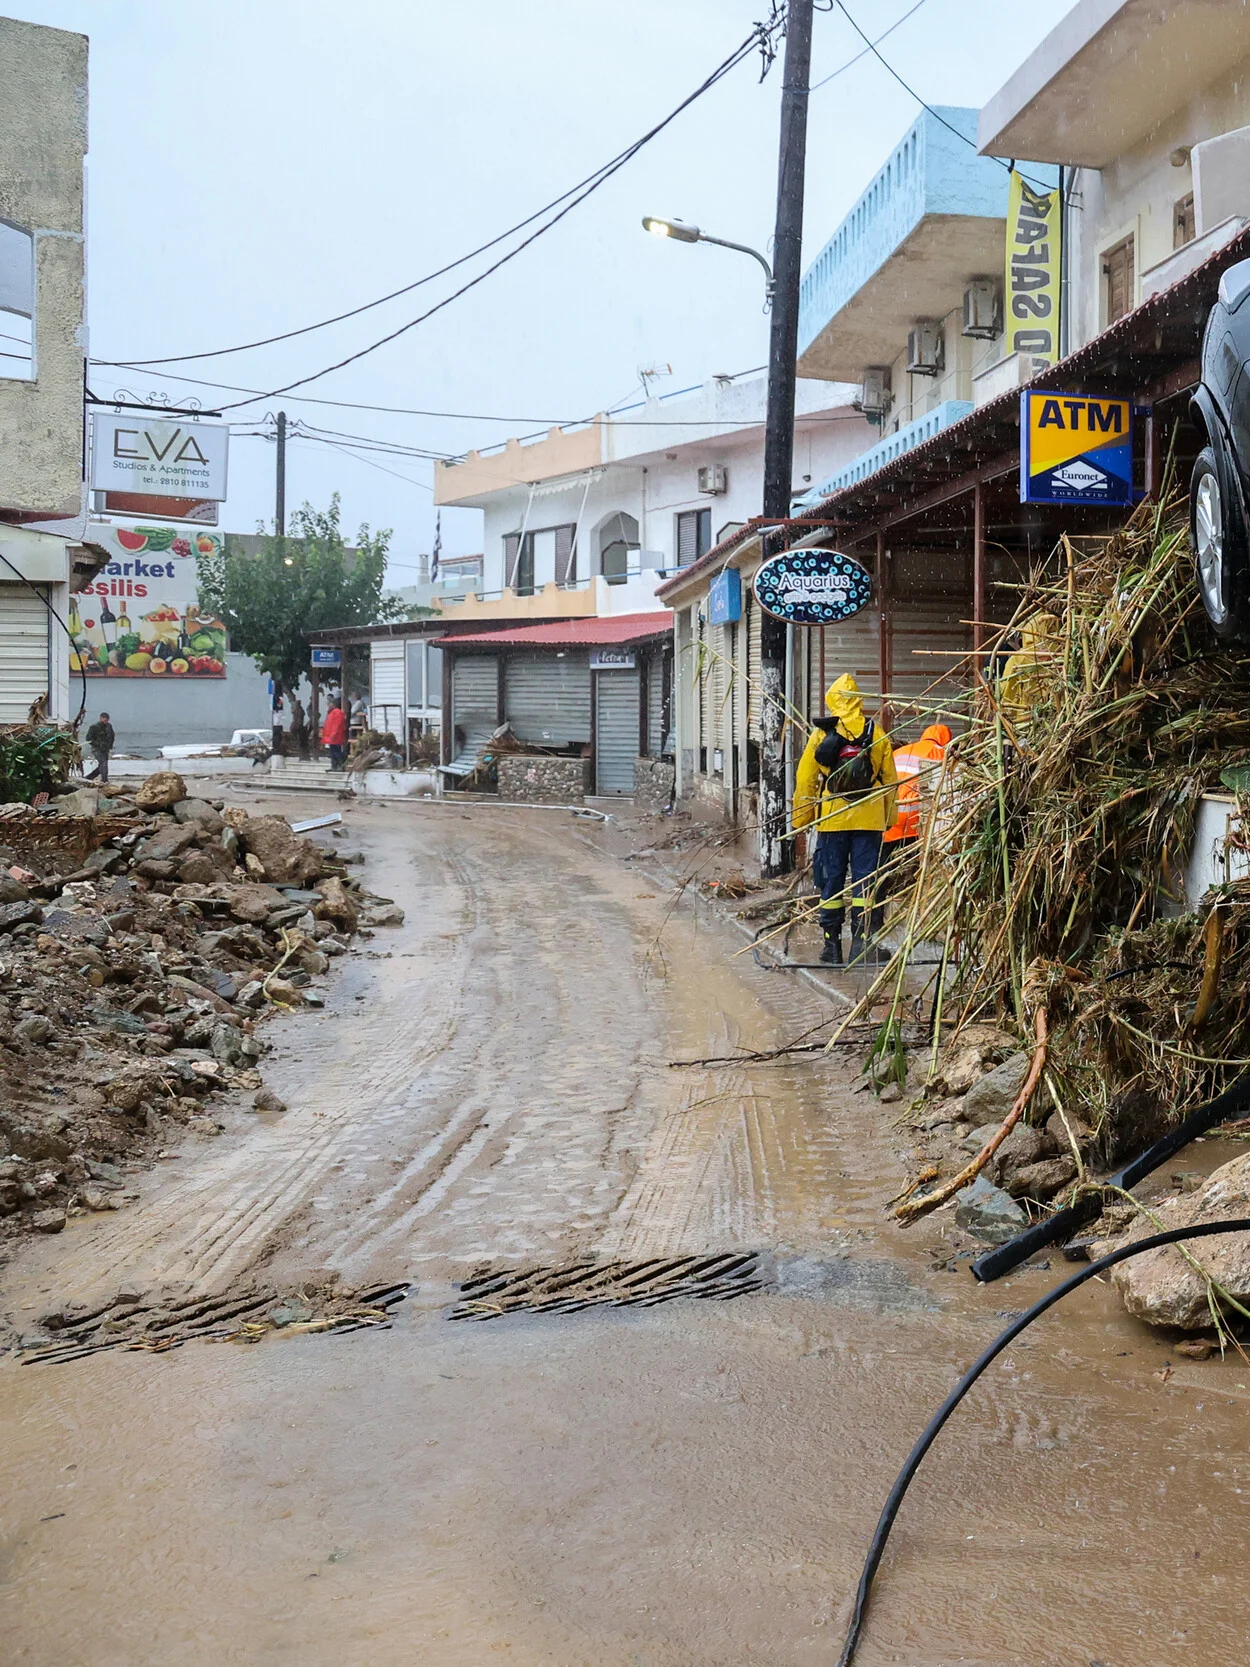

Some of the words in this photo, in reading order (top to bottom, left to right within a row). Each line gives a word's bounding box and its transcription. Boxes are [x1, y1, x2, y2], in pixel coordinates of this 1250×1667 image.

[1037, 399, 1123, 434] ATM
[113, 428, 210, 466] EVA
[112, 460, 148, 472] Studios
[149, 463, 157, 472] &
[158, 464, 210, 477] Apartments
[1061, 469, 1099, 481] Euronet
[159, 477, 180, 486] 2810
[180, 479, 210, 489] 811135
[1051, 490, 1108, 498] WORLDWIDE
[100, 559, 175, 578] arket
[73, 579, 148, 598] ssilis
[779, 572, 850, 591] Aquarius
